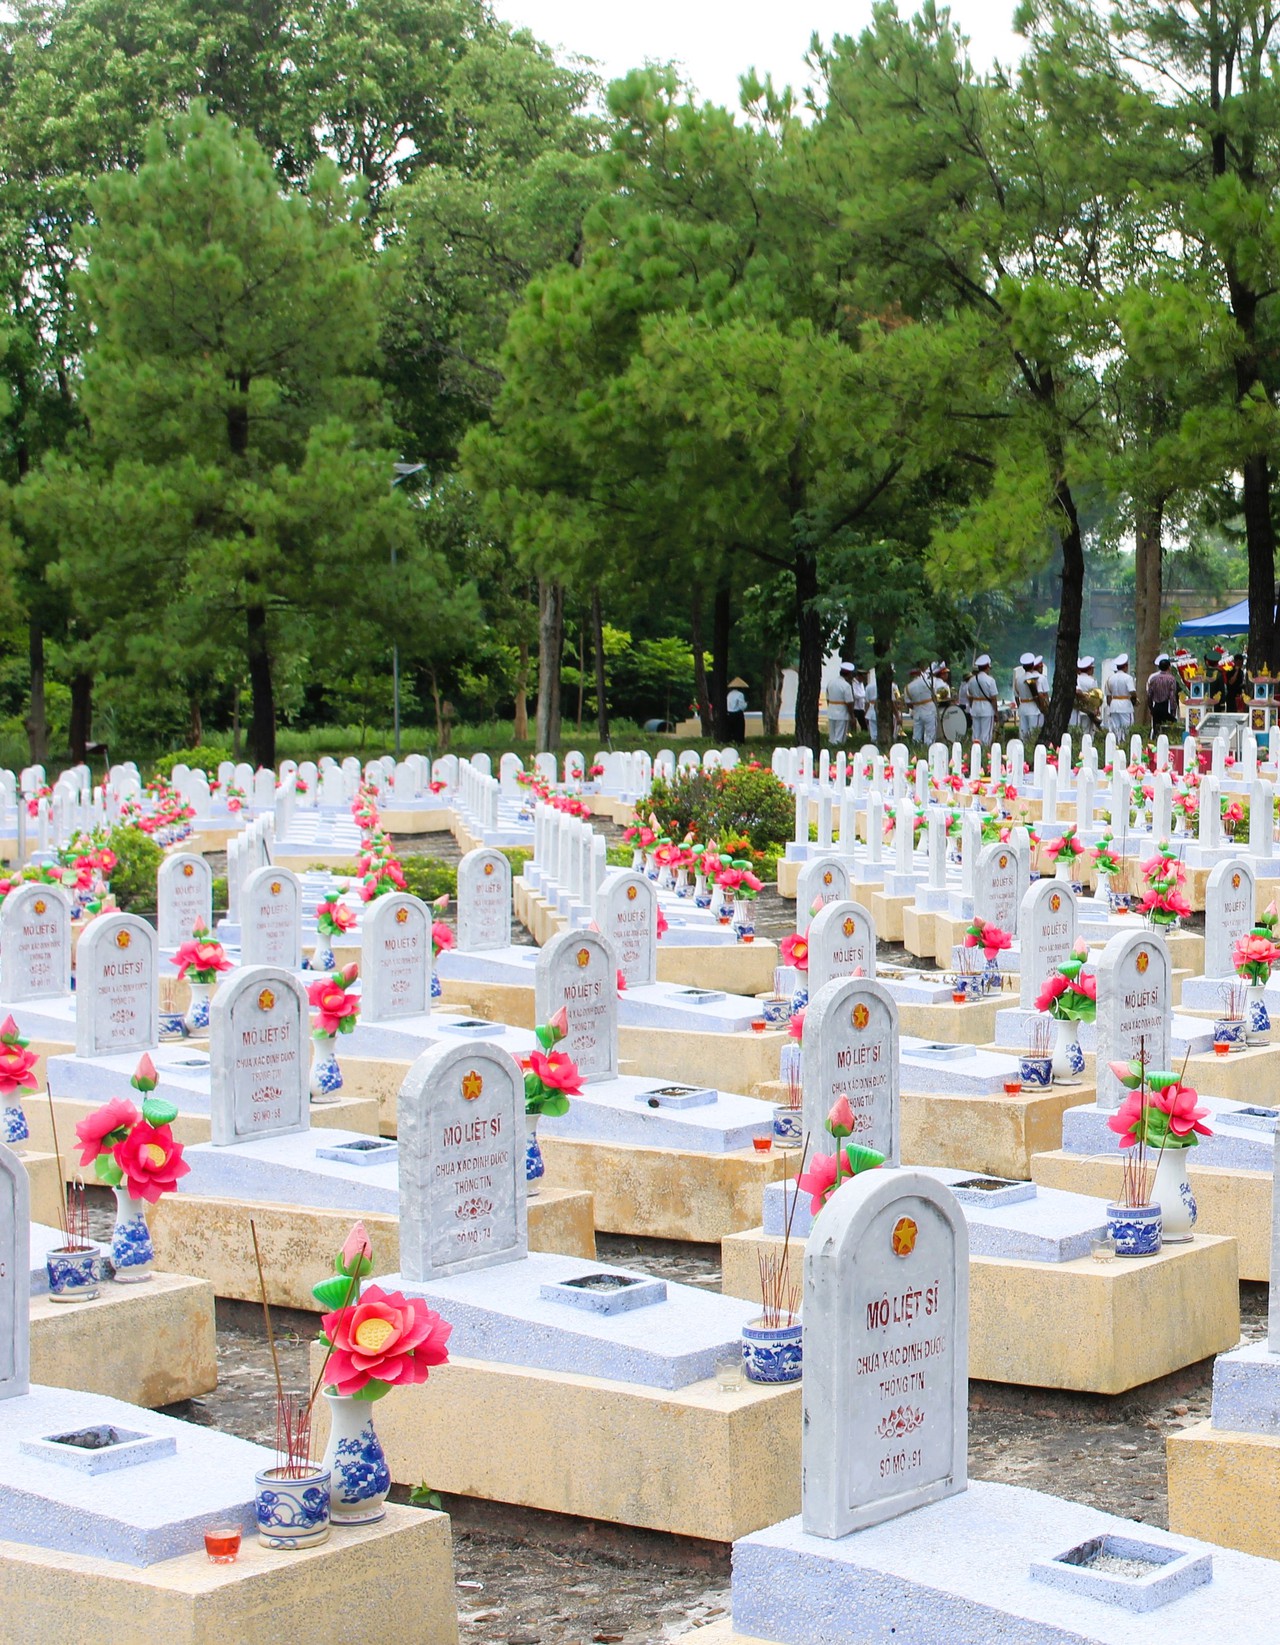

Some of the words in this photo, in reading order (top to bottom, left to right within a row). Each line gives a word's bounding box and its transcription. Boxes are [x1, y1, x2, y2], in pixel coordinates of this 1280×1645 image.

[838, 1045, 851, 1071] MỘ
[854, 1043, 871, 1068] LIỆT
[873, 1041, 882, 1062] SĨ
[849, 1094, 864, 1108] HÔNG
[443, 1119, 462, 1150] MỘ
[465, 1116, 488, 1146] LIỆT
[490, 1112, 502, 1138] SĨ
[435, 1159, 455, 1178] CHƯA
[455, 1176, 479, 1195] THÔNG
[480, 1174, 492, 1189] TIN
[866, 1291, 890, 1335] MỘ
[893, 1287, 923, 1328] LIỆT
[925, 1279, 940, 1316] SĨ
[856, 1349, 880, 1376] CHƯA
[882, 1342, 901, 1370] XÁC
[902, 1345, 923, 1369] ĐỊNH
[924, 1336, 946, 1365] ĐƯỢC
[879, 1373, 908, 1402] THÔNG
[909, 1370, 926, 1392] TIN
[879, 1449, 891, 1479] SỐ
[892, 1448, 907, 1476] MỘ
[911, 1448, 922, 1469] 91
